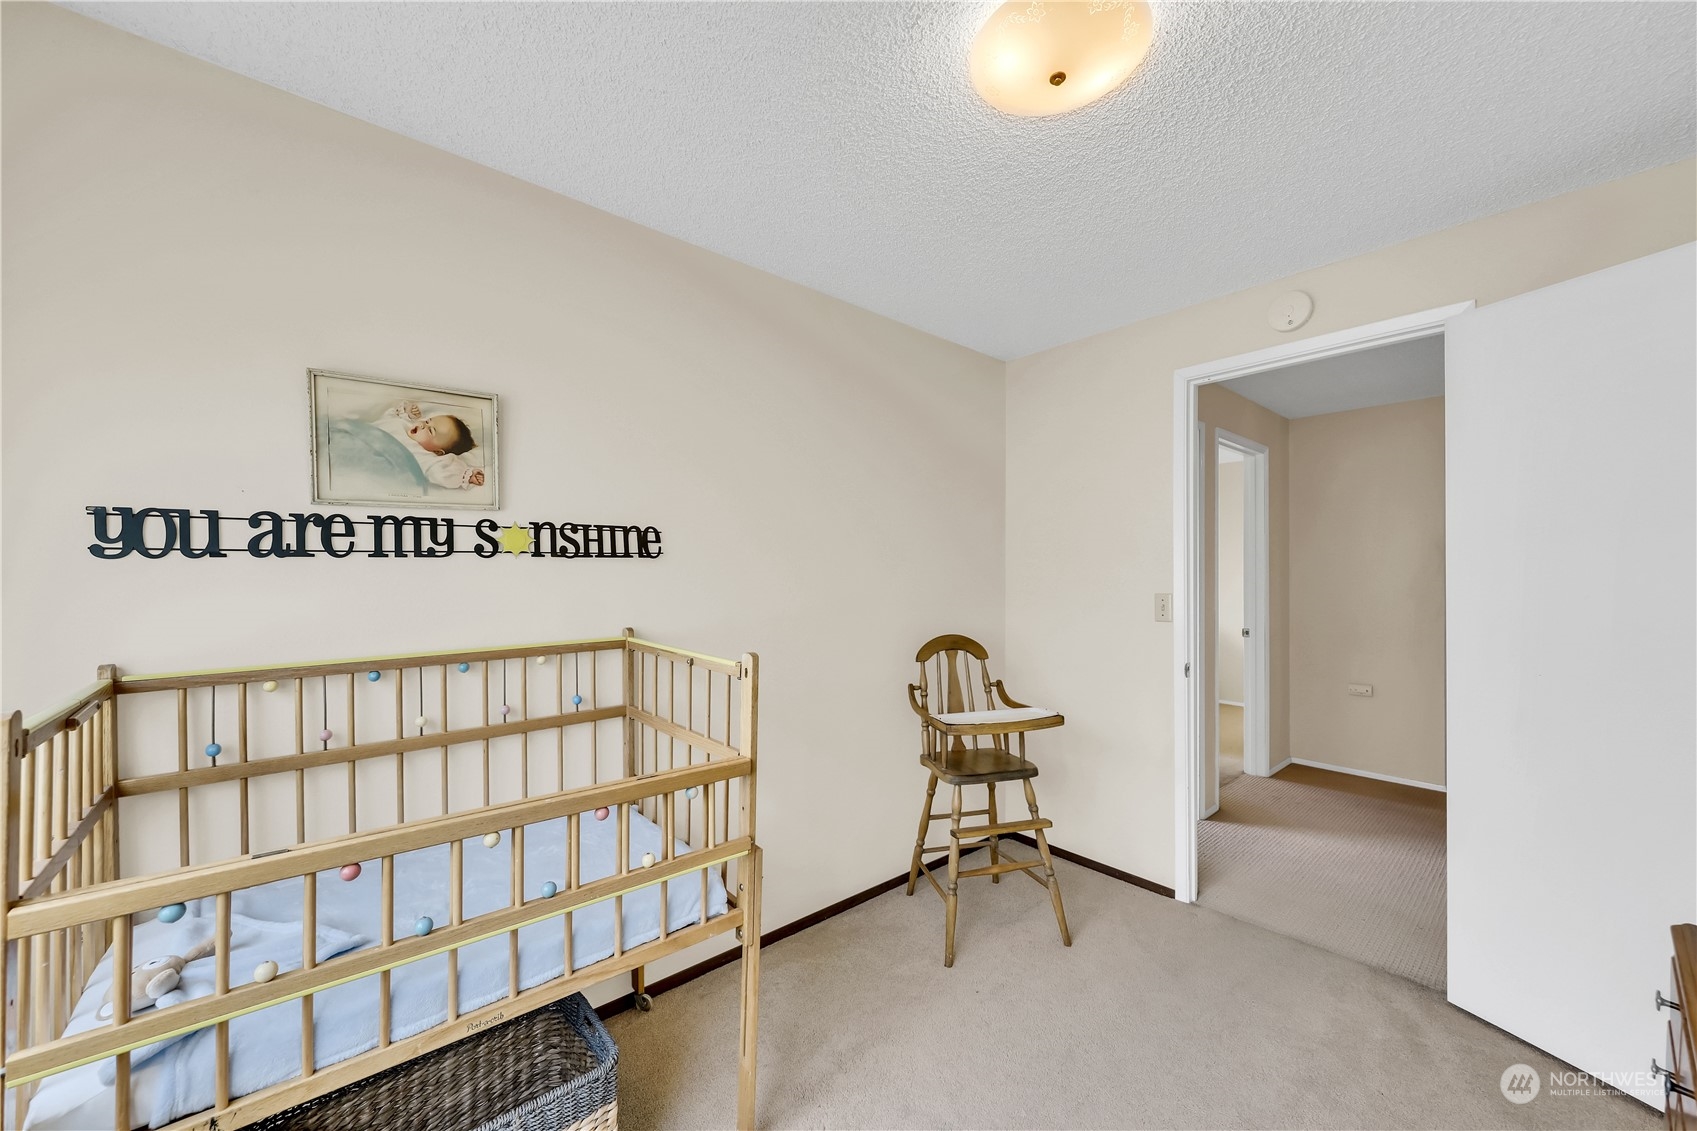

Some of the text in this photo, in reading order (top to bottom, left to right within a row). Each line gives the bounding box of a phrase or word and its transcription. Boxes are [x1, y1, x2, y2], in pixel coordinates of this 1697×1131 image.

[86, 506, 227, 559] you
[247, 511, 356, 559] are
[367, 515, 454, 558] my
